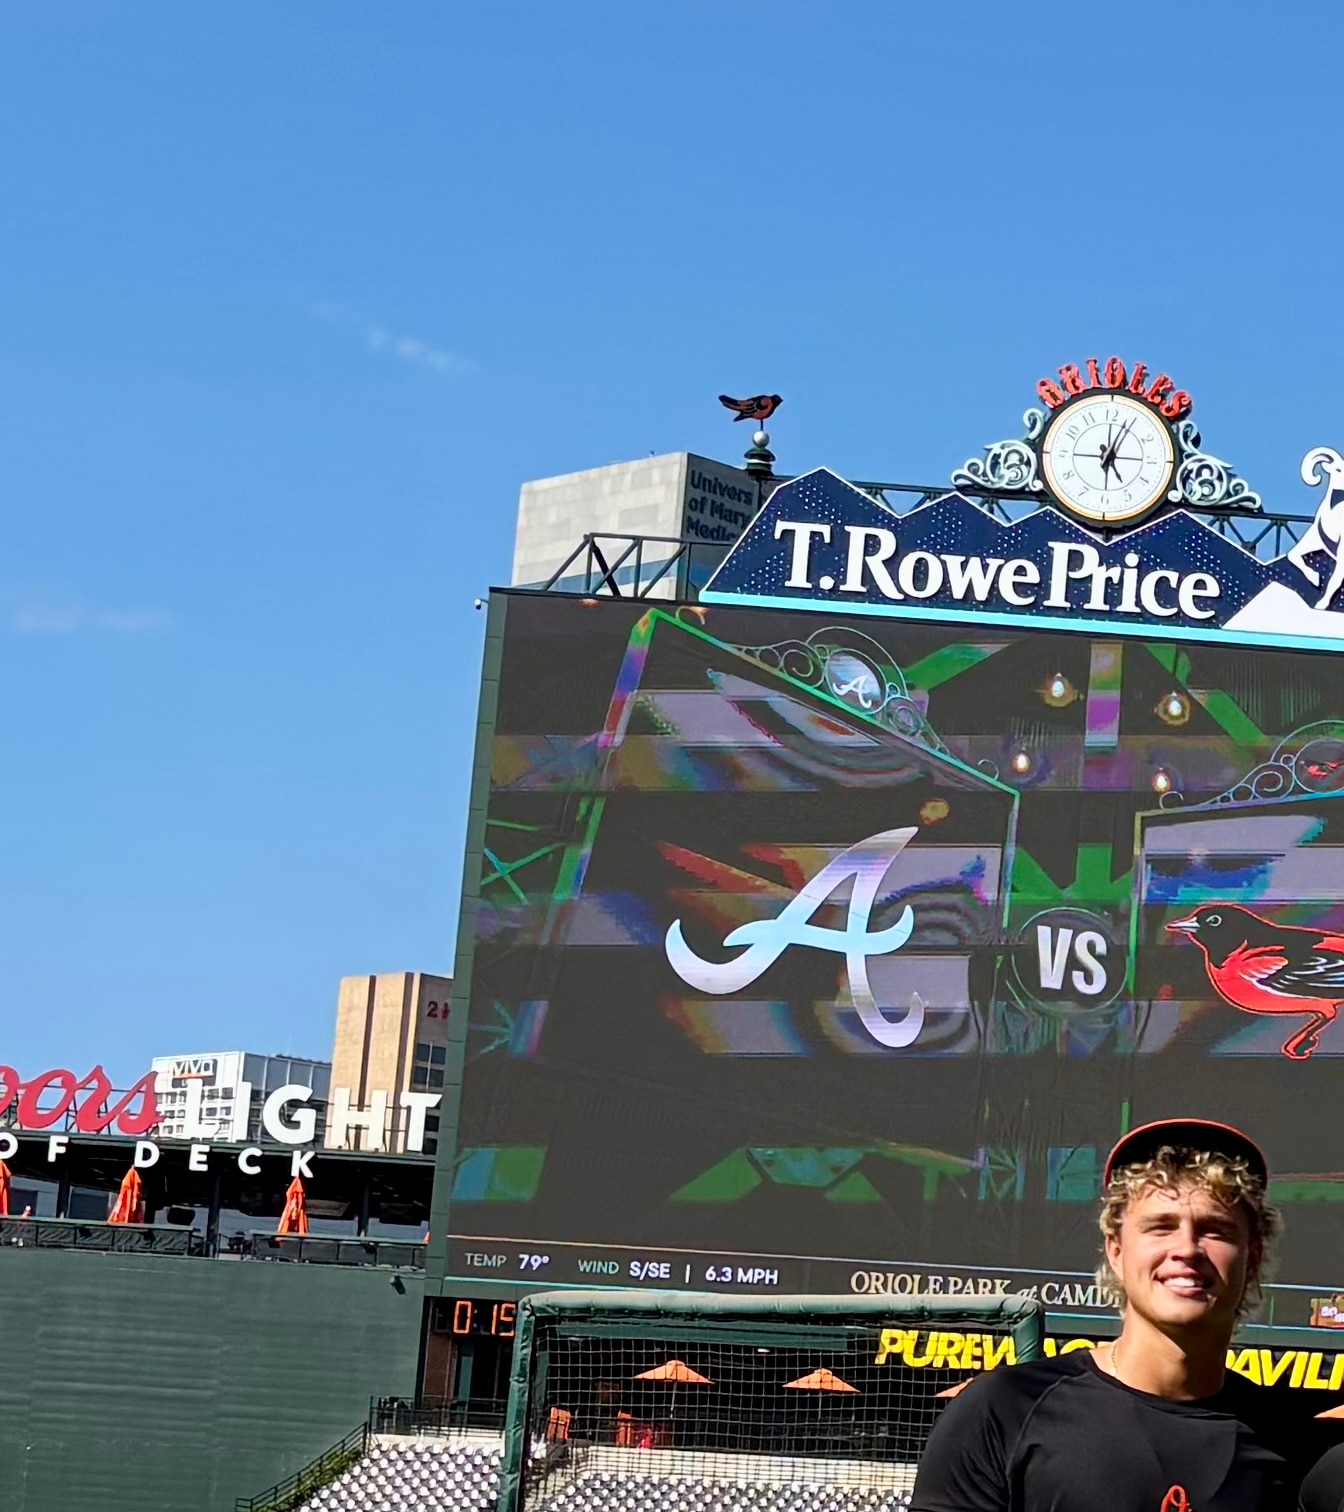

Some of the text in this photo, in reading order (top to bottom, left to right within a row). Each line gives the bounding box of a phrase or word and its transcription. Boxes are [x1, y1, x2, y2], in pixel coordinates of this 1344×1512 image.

[1037, 356, 1192, 421] ORIOLES
[688, 499, 706, 514] of
[1037, 925, 1107, 995] VS
[181, 1078, 443, 1153] LIGHT
[134, 1140, 314, 1179] DECK
[465, 1252, 507, 1267] TEMP
[578, 1259, 620, 1274] WIND
[629, 1261, 671, 1279] S/SE
[705, 1266, 733, 1283] 6.3
[737, 1267, 778, 1285] MPH
[851, 1270, 943, 1296] ORIOLE
[949, 1276, 1012, 1296] PARK
